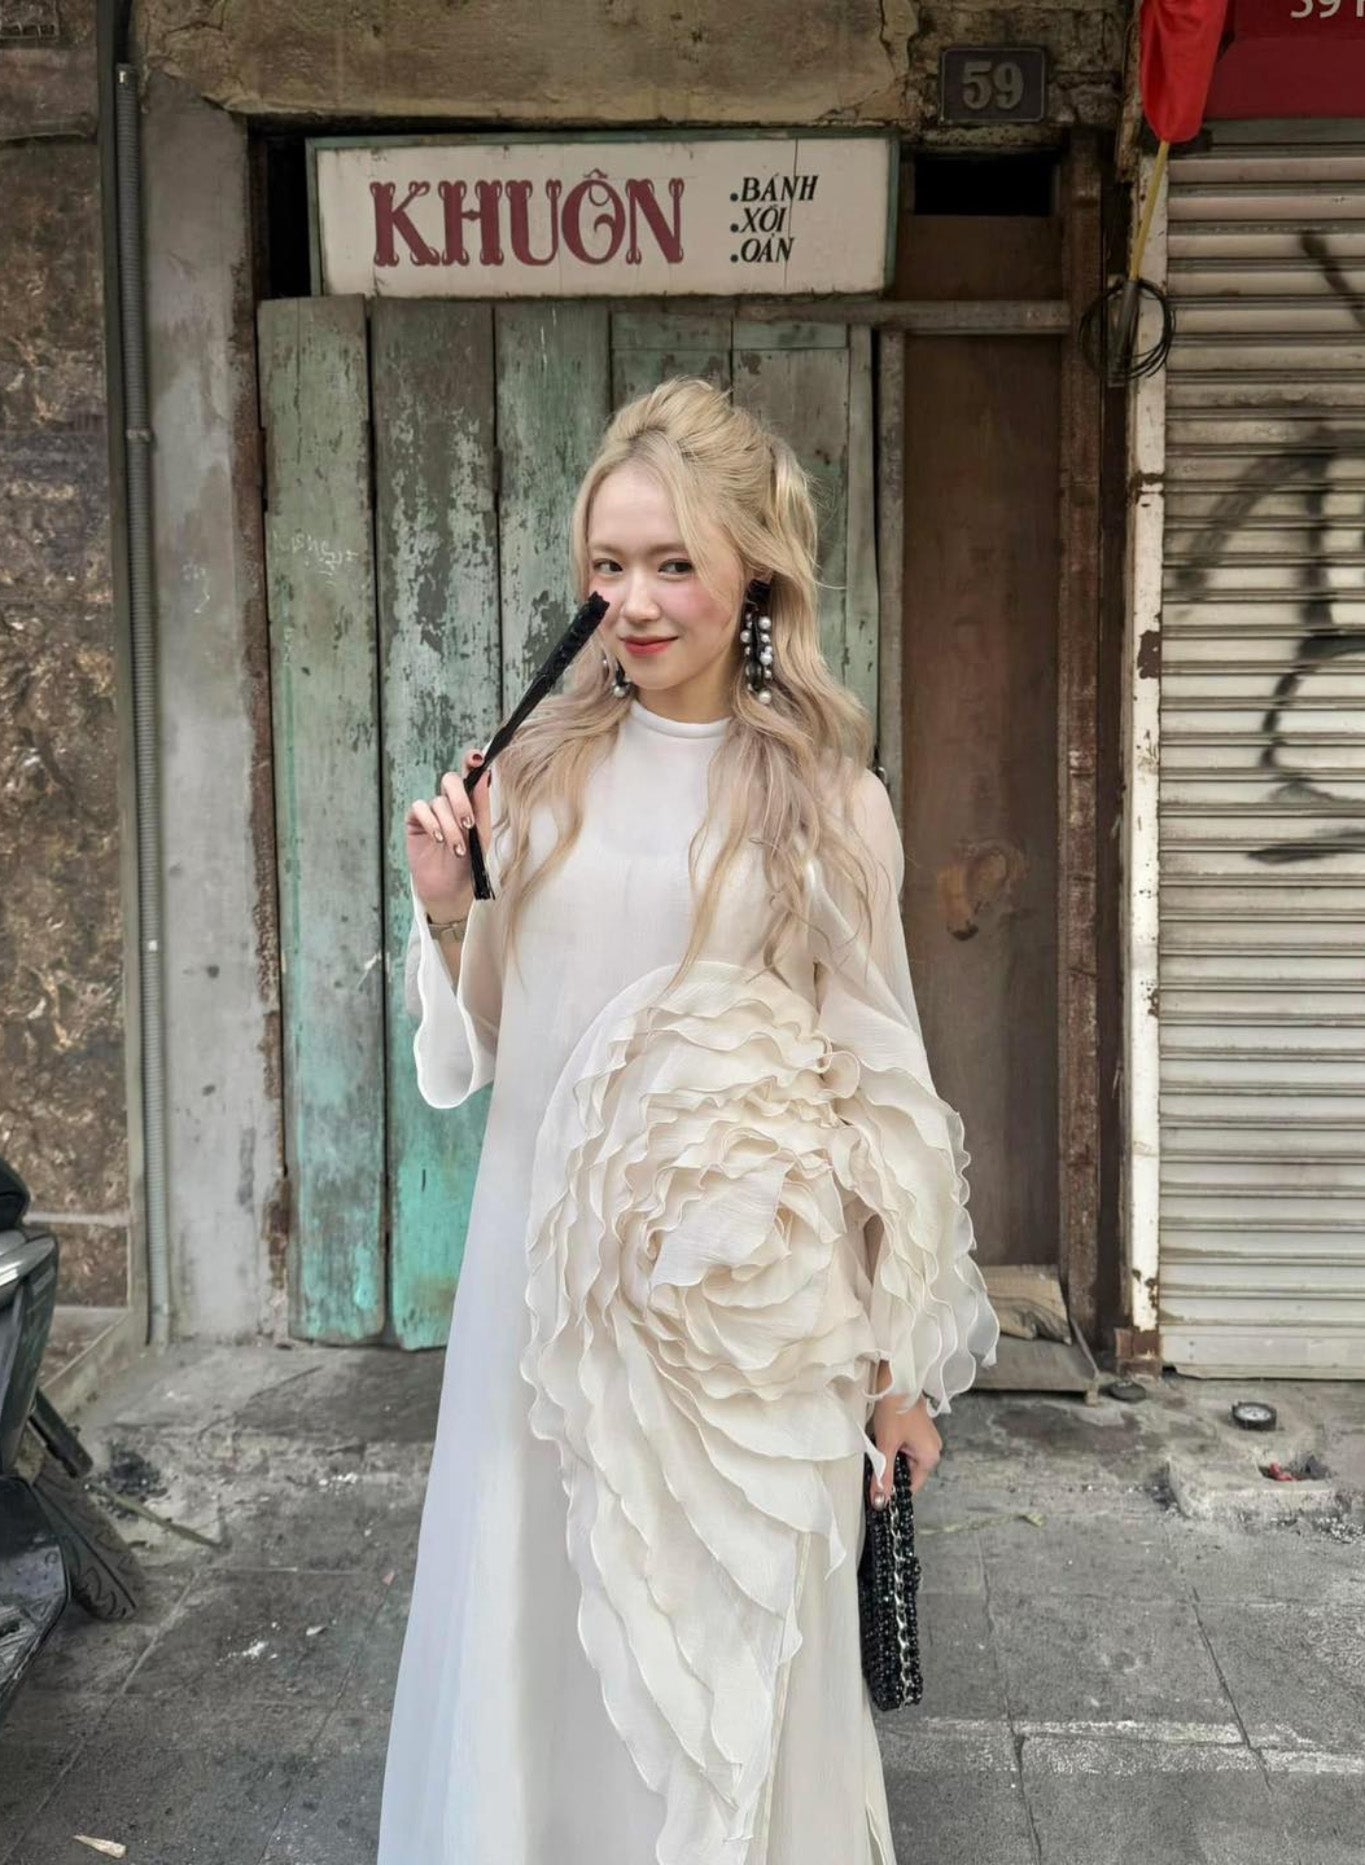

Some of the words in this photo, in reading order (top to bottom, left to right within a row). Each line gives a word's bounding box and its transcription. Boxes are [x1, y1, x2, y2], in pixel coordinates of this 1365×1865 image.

[961, 61, 1024, 110] 59
[740, 172, 819, 202] BÁNH
[369, 168, 686, 267] KHUÔN
